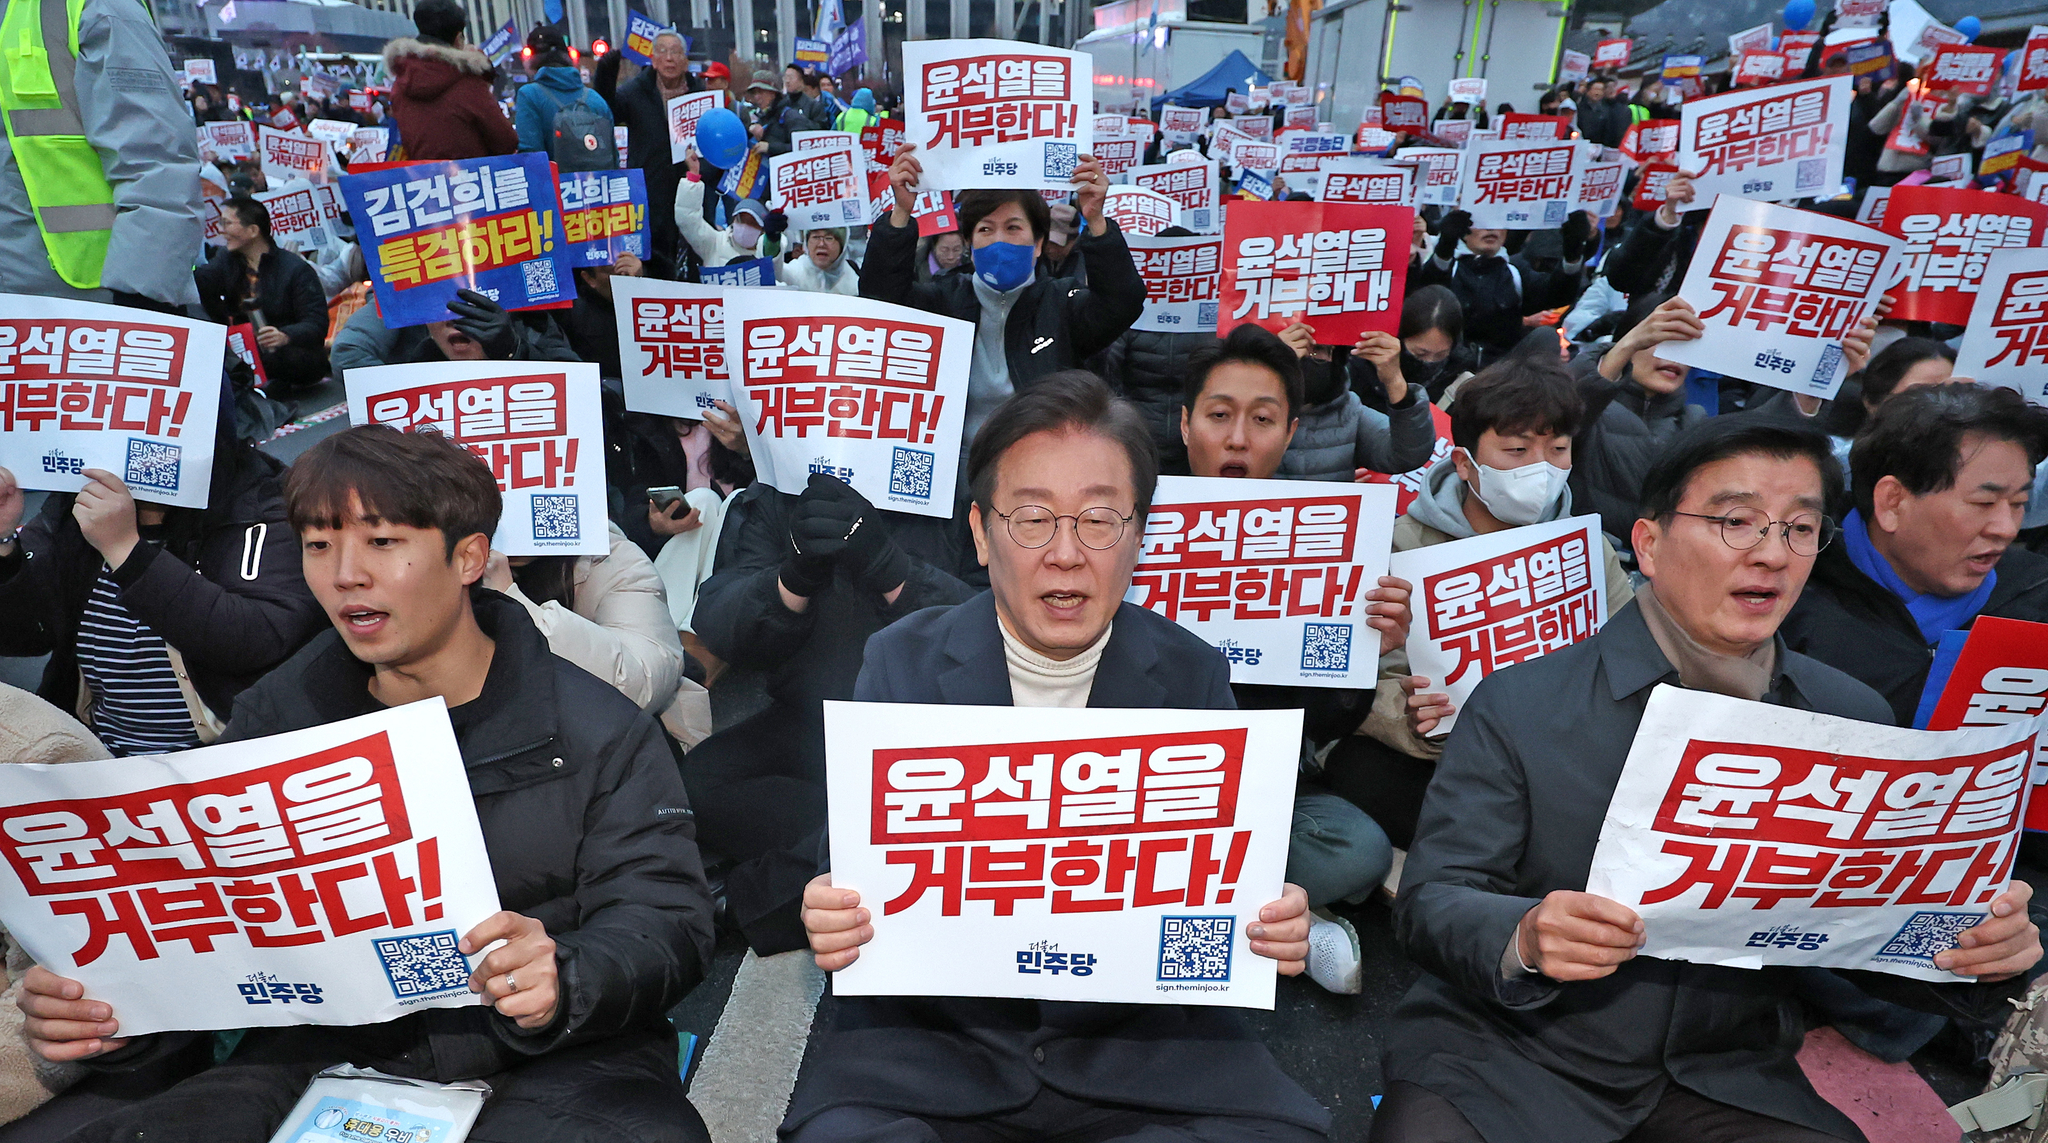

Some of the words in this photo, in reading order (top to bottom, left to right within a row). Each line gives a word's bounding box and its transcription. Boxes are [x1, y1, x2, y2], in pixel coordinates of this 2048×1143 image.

[926, 59, 1066, 107] 윤석열을
[926, 103, 1079, 150] 거부한다!
[1699, 91, 1825, 147] 윤석열을
[983, 161, 1018, 176] 민주당
[1094, 141, 1135, 159] 석열을
[1479, 149, 1570, 180] 윤석열을
[1695, 123, 1834, 180] 거부한다!
[778, 153, 852, 187] 윤석열을
[1326, 176, 1402, 200] 윤석열을
[1427, 171, 1459, 186] 한다!
[364, 165, 530, 236] 김건희를
[560, 175, 631, 210] 건희를
[779, 177, 858, 209] 거부한다!
[1474, 175, 1574, 205] 거부한다!
[564, 204, 645, 245] 검하라!
[1901, 213, 2033, 254] 윤석열을
[378, 210, 554, 285] 특검하라!
[1236, 228, 1387, 279] 윤석열을
[1720, 232, 1882, 293] 윤석열을
[1145, 275, 1221, 304] 부한다!
[1884, 252, 1991, 293] 거부한
[1232, 270, 1393, 320] 거부한다!
[1699, 281, 1868, 342] 거부한다!
[637, 302, 725, 340] 윤석열
[641, 344, 730, 380] 거부한
[745, 321, 936, 387] 윤석열을
[1754, 352, 1797, 375] 민주당
[750, 386, 945, 444] 거부한다!
[42, 455, 85, 475] 민주당
[126, 484, 178, 498] ign.theminjoo.kr
[1142, 503, 1349, 564] 윤석열을
[1131, 564, 1364, 622] 거부한다!
[1433, 537, 1589, 631] 윤석열을
[1214, 646, 1263, 666] 주당
[884, 742, 1227, 835] 윤석열을
[1672, 749, 2029, 842] 윤석열을
[2, 755, 390, 884] 윤석열을
[883, 830, 1253, 917] 거부한다!
[1638, 831, 2020, 910] 거부한다!
[49, 837, 445, 968] 거부한다!
[1028, 940, 1059, 953] 더불어
[1744, 930, 1830, 952] 민주당
[245, 971, 279, 985] 더불어
[1016, 951, 1098, 976] 민주당
[236, 982, 325, 1007] 민주당
[397, 989, 474, 1008] sign.theminjoo.
[1155, 983, 1231, 994] sign.theminjoo.kr
[343, 1117, 385, 1138] 휴대용
